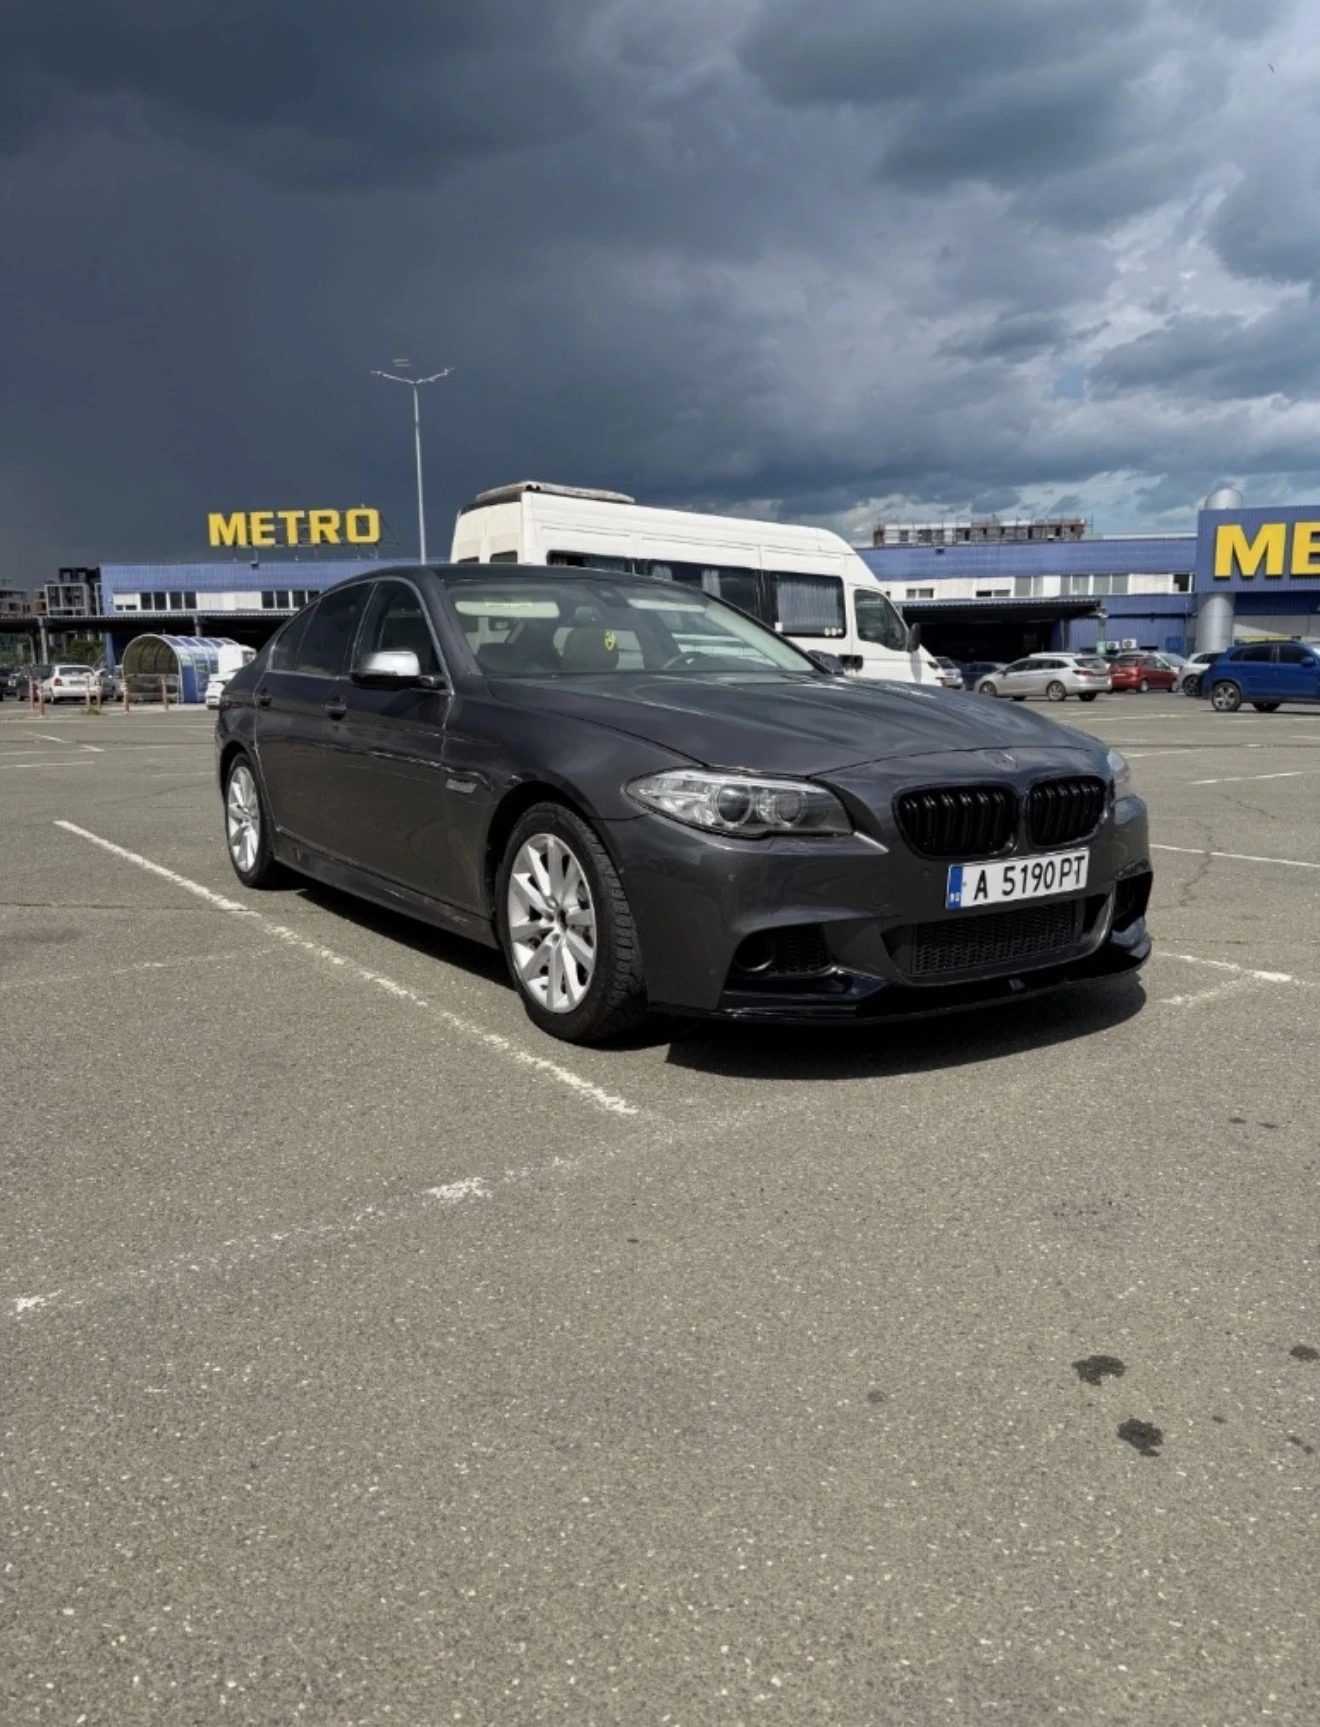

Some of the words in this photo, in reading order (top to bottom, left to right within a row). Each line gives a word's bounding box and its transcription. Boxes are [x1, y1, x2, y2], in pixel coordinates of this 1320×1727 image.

[208, 508, 379, 546] METRO
[1214, 522, 1320, 577] ME
[974, 869, 988, 900] A
